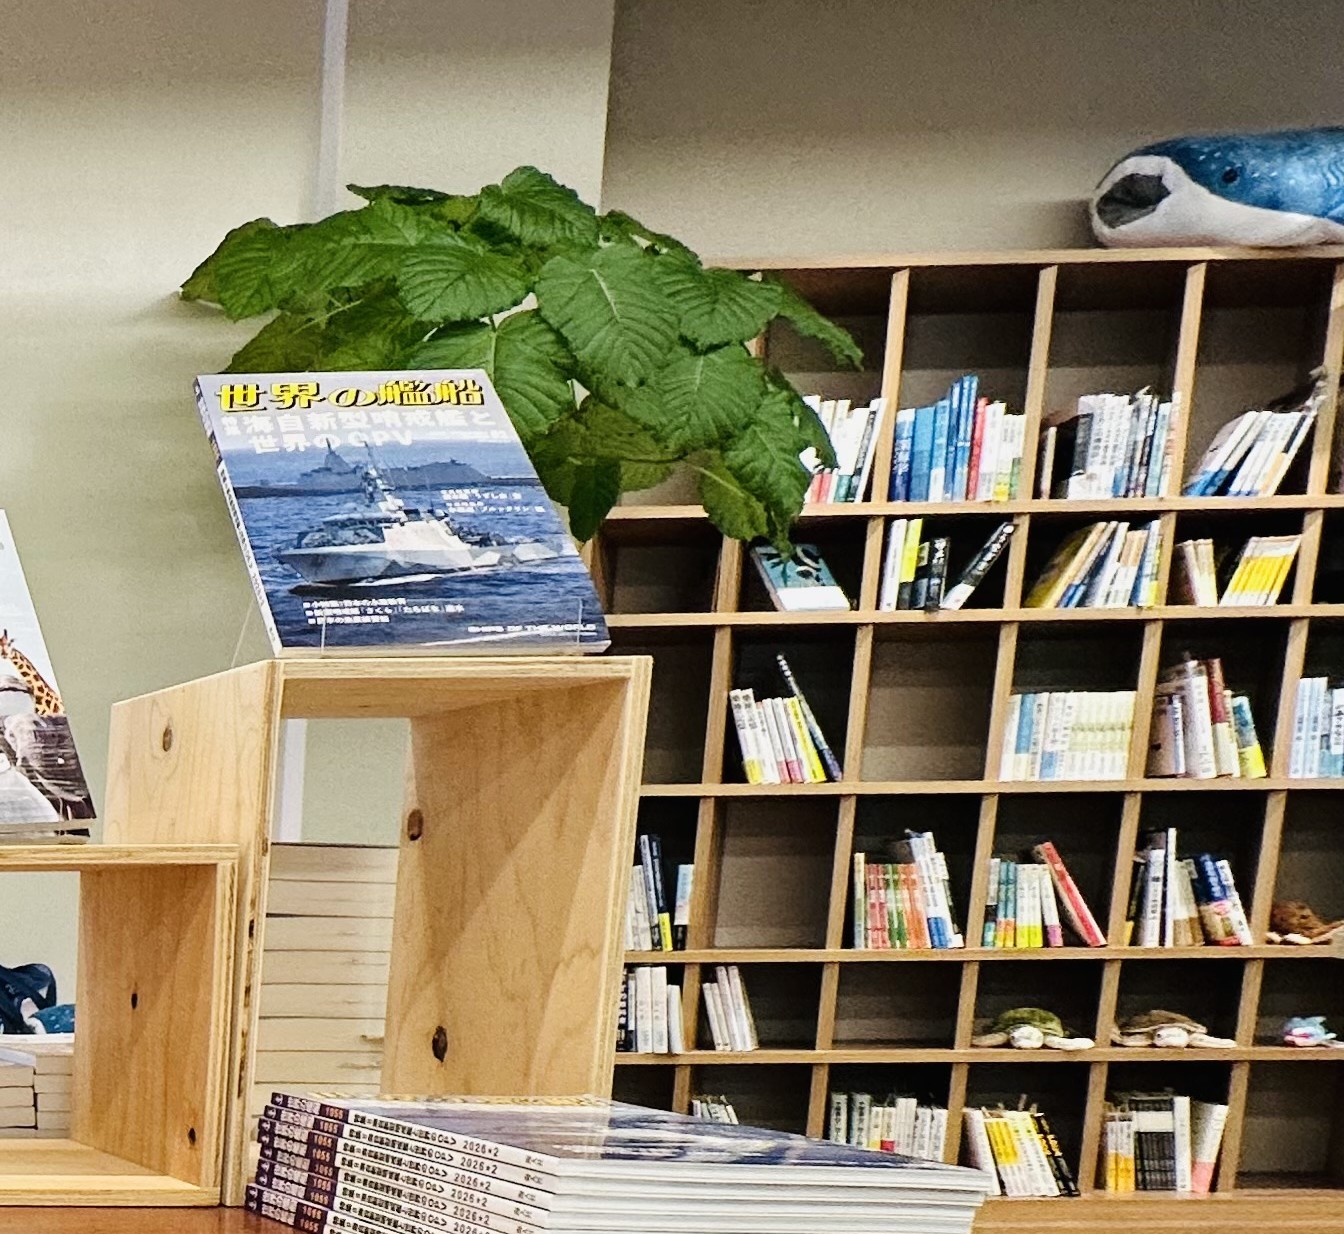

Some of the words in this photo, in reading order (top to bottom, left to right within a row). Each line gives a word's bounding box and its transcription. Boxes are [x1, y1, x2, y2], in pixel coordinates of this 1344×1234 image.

[216, 380, 484, 412] 世界の艦船
